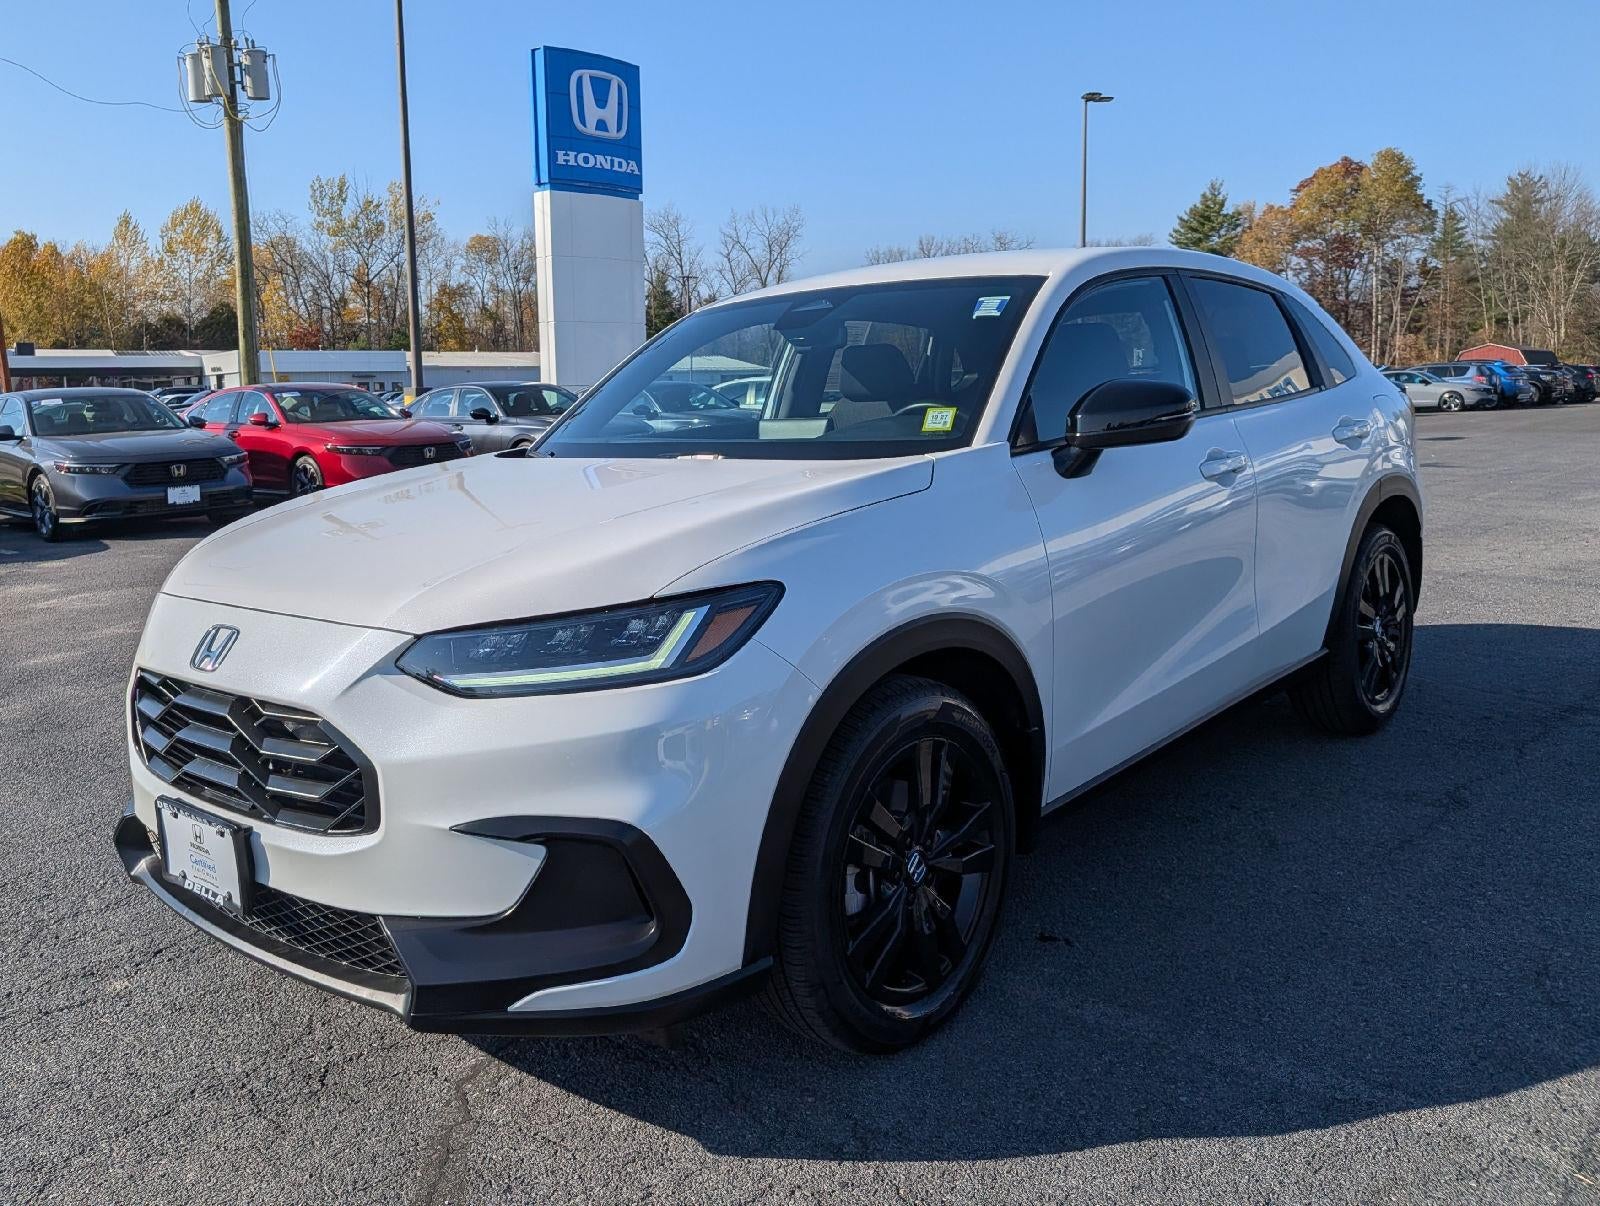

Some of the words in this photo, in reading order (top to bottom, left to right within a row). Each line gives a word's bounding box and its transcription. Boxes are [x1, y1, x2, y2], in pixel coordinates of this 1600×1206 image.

[555, 150, 641, 175] HONDA
[189, 853, 217, 873] Certified
[184, 878, 224, 906] DELLA
